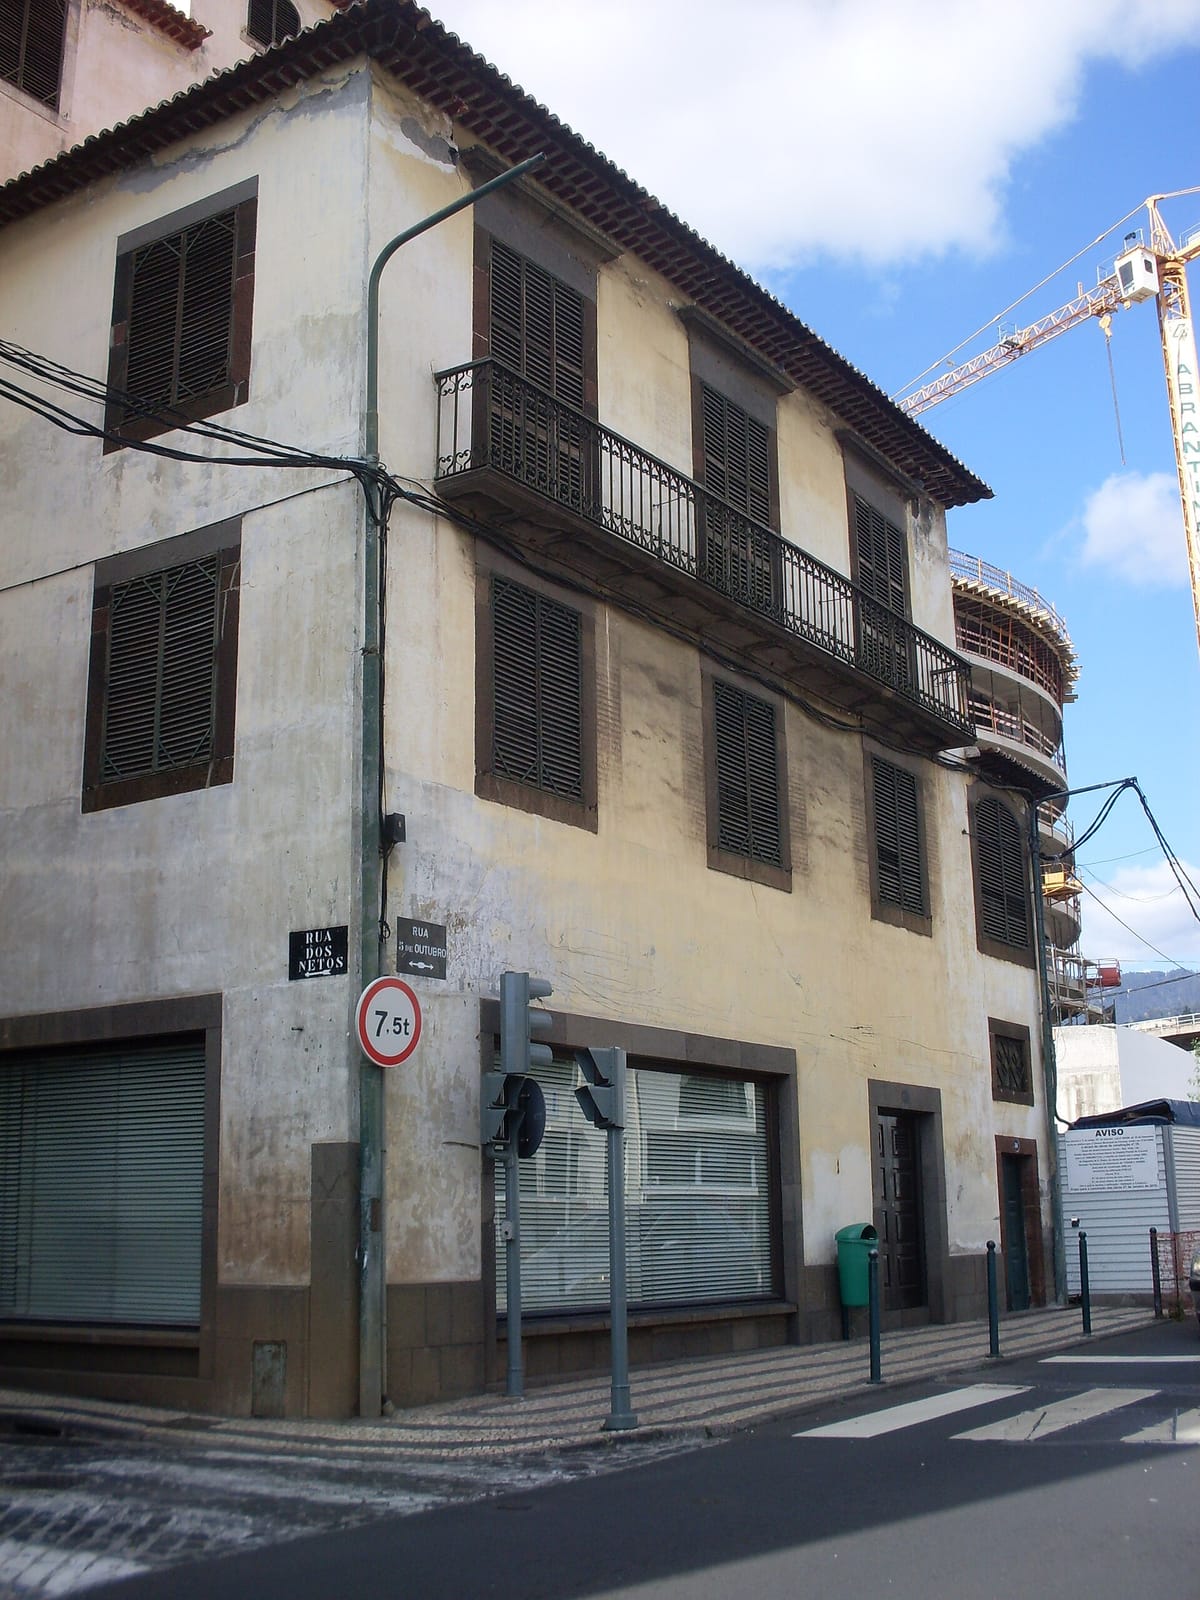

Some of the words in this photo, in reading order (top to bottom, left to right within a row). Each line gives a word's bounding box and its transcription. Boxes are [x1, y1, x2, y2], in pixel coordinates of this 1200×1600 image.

[305, 930, 332, 944] RUA
[412, 926, 429, 938] RUA
[305, 945, 332, 960] DOS
[298, 956, 344, 973] NETOS
[1095, 1128, 1124, 1137] AVISO
